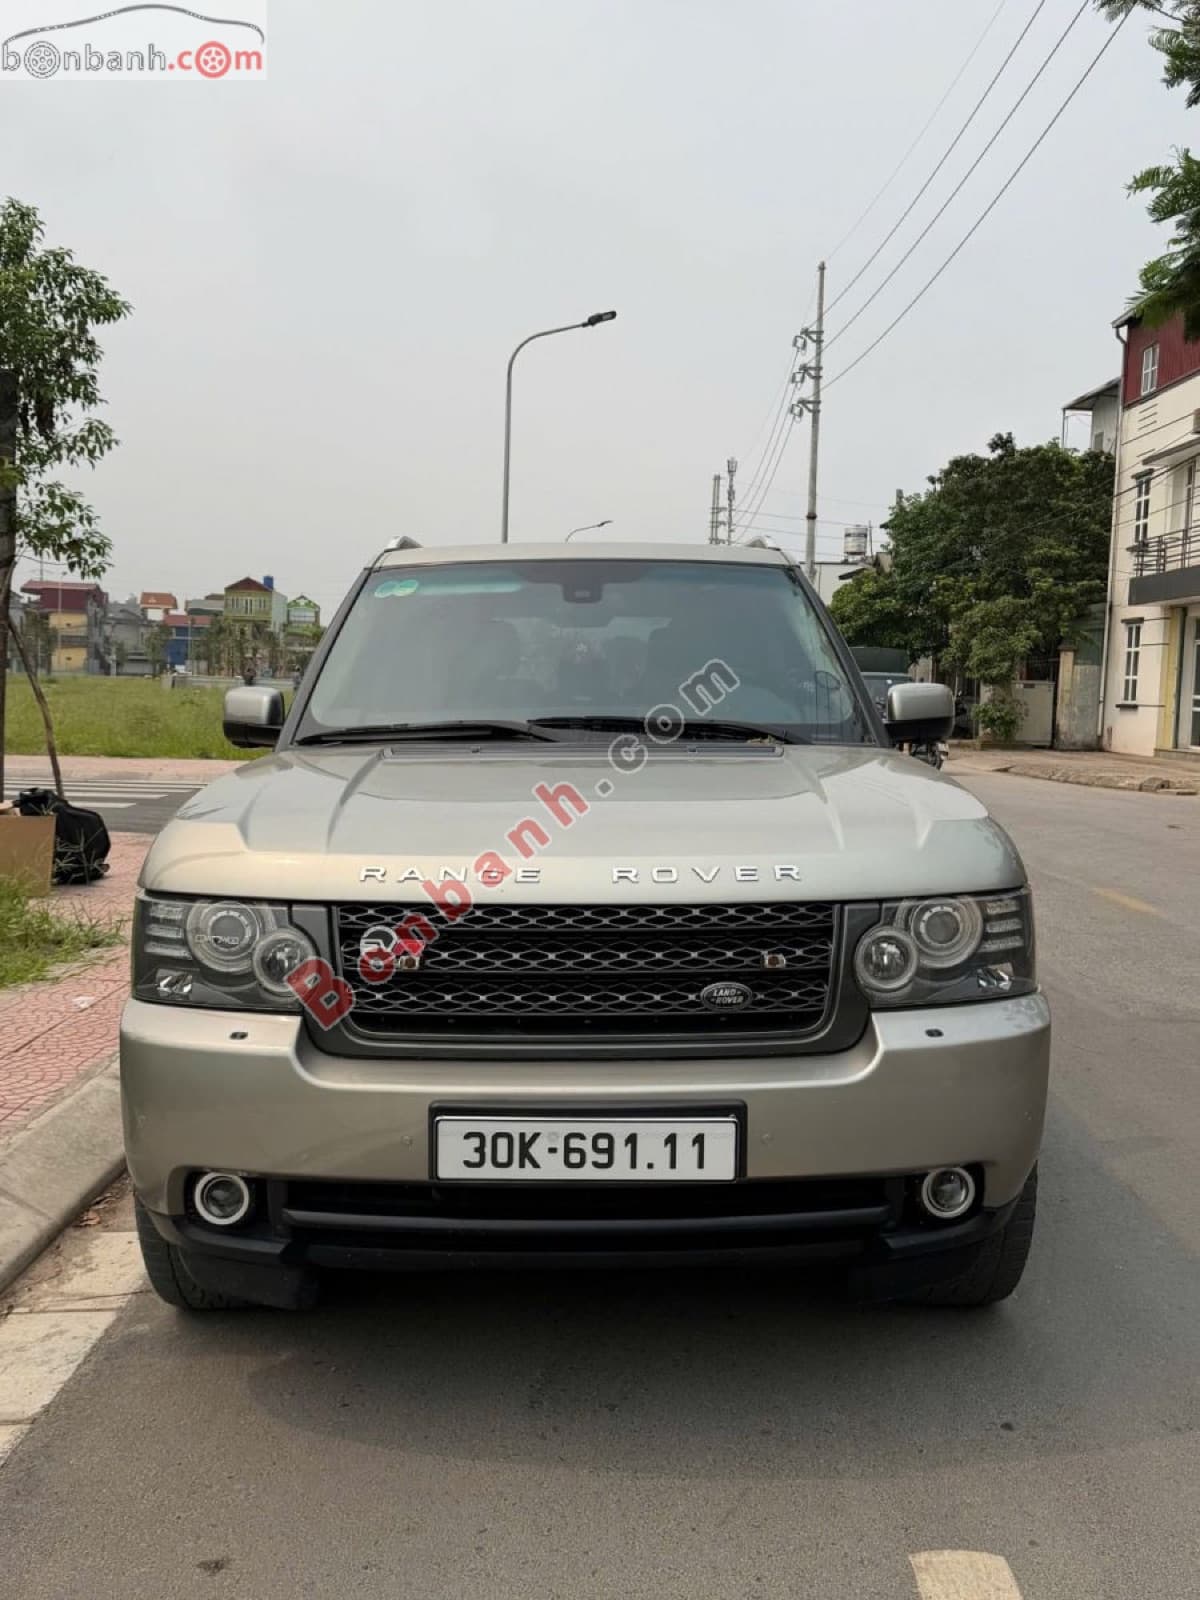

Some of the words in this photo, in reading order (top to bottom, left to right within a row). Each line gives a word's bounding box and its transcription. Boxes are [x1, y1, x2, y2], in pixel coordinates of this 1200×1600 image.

[359, 866, 542, 884] RANGE
[612, 864, 804, 883] ROVER
[462, 1131, 706, 1170] 30K-691.11
